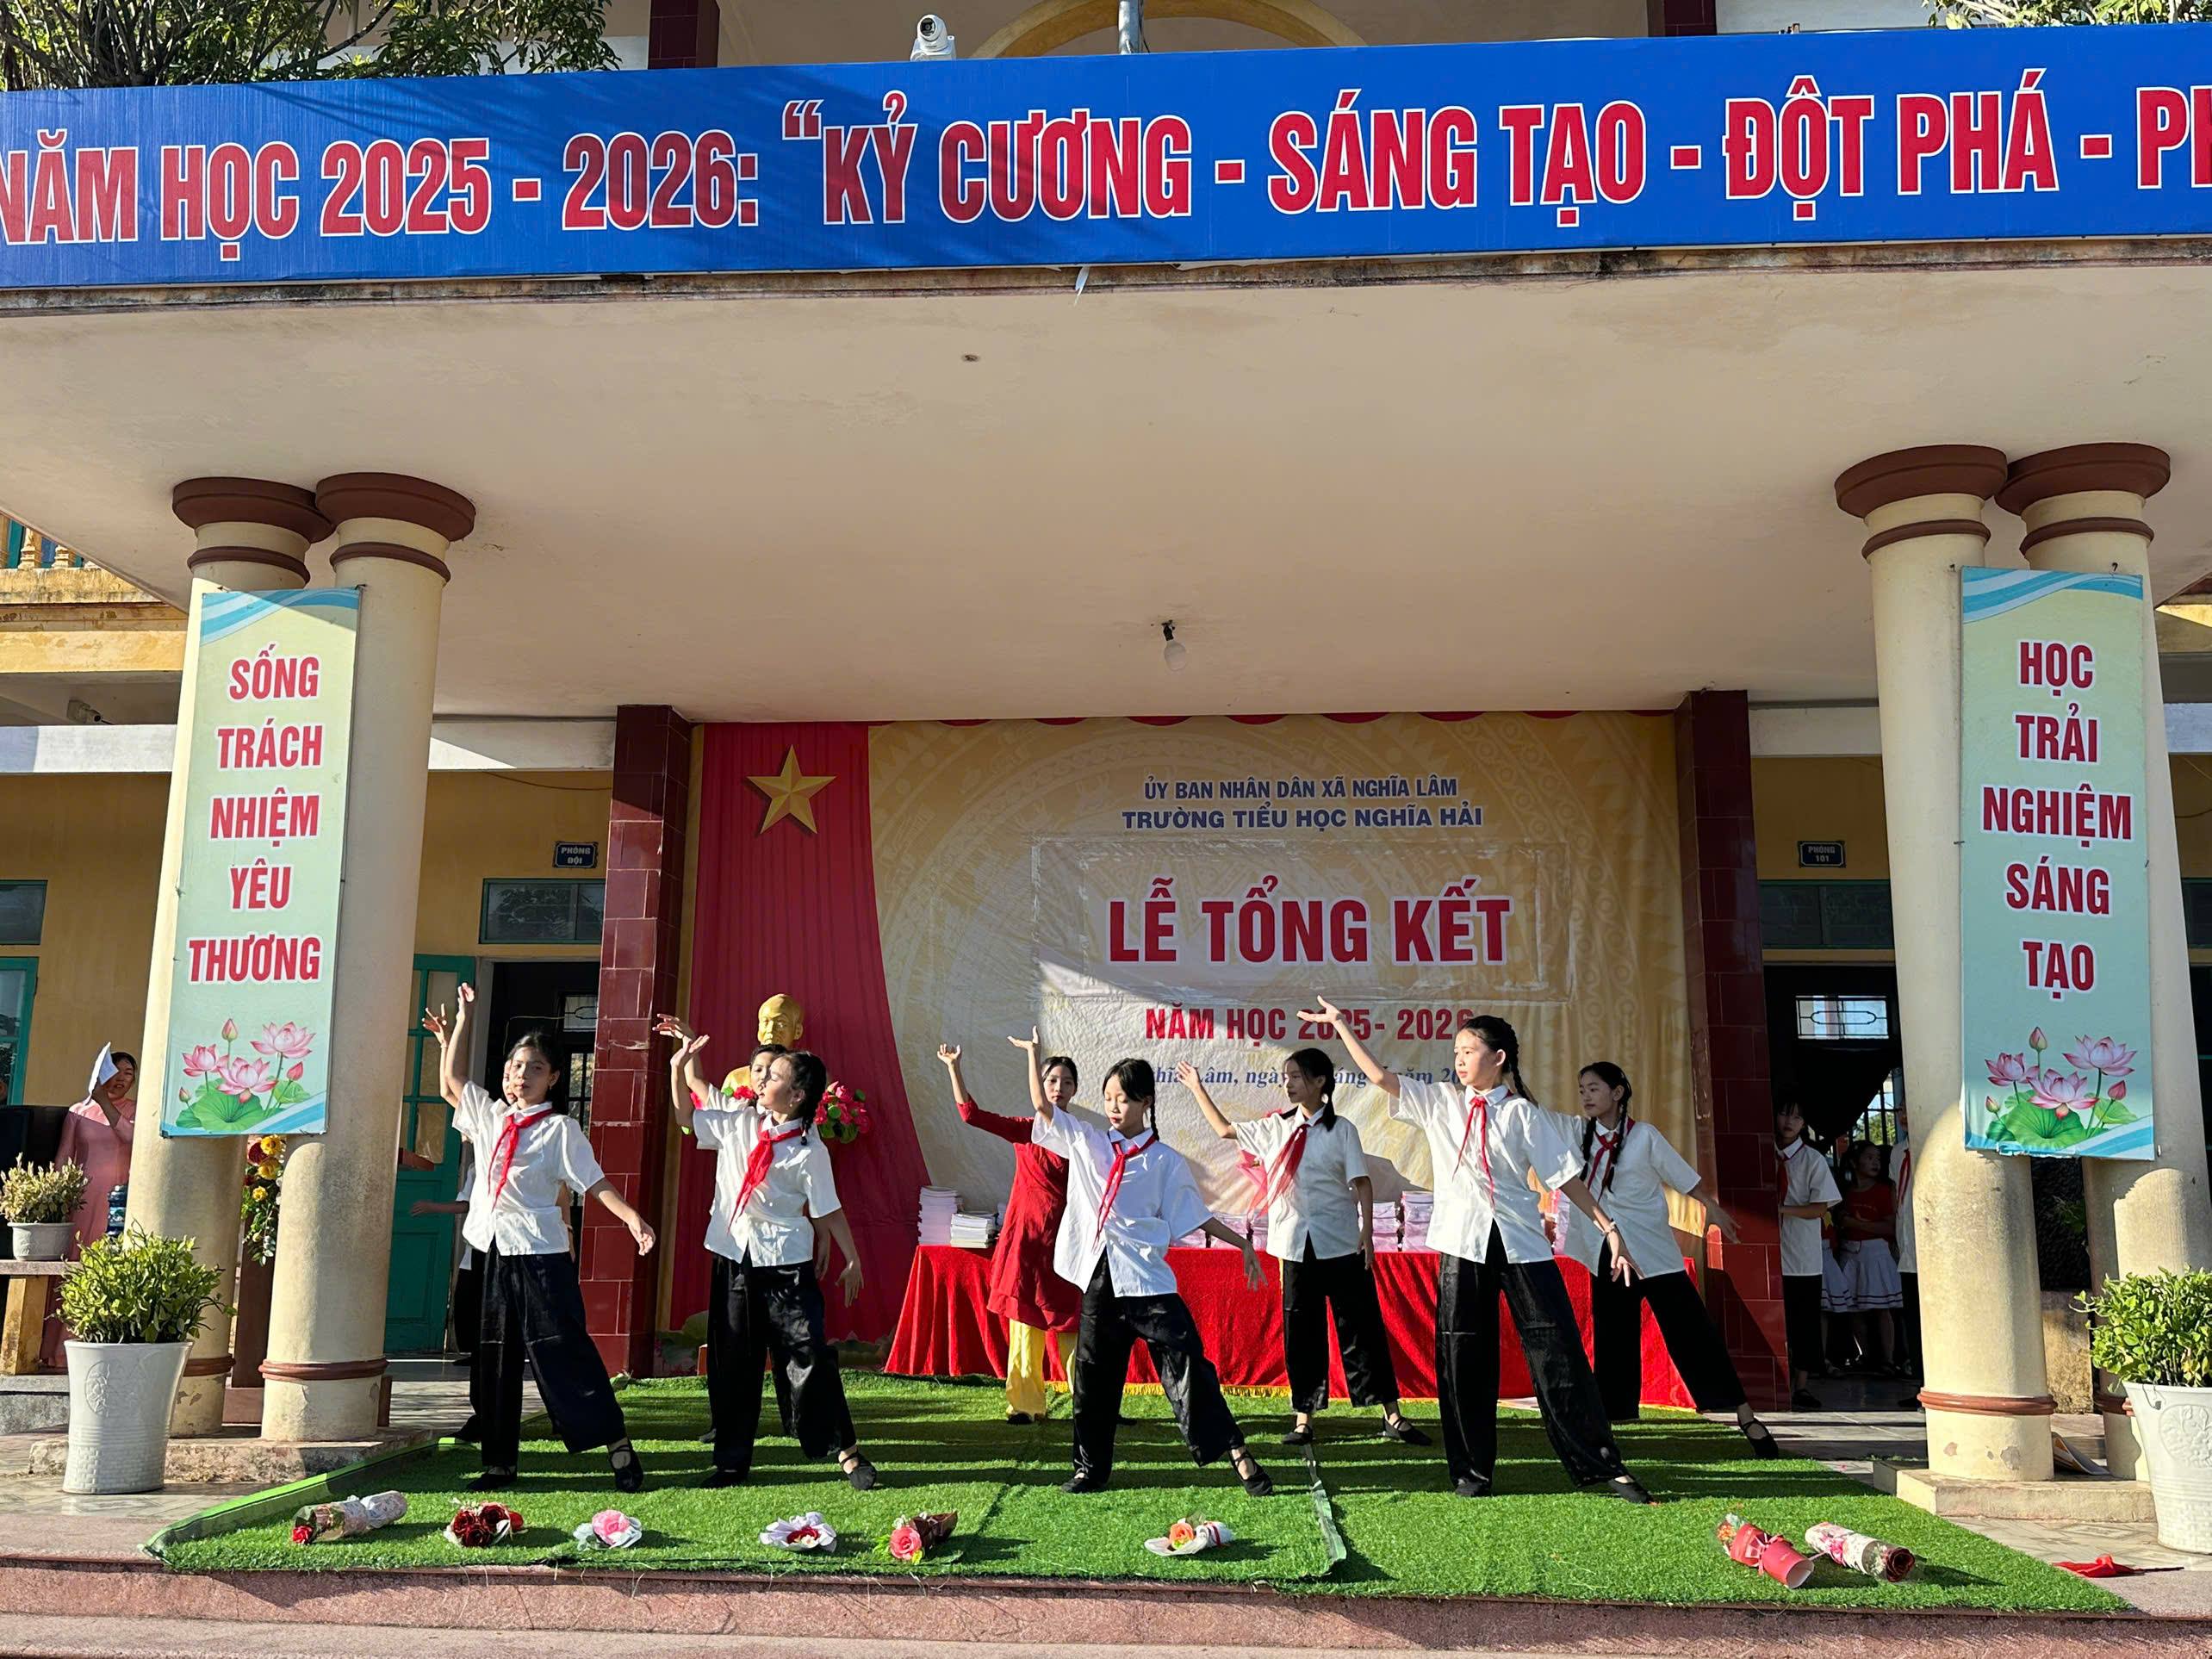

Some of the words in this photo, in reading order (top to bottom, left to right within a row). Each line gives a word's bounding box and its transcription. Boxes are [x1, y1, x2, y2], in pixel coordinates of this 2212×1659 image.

[160, 141, 299, 262] HỌC
[320, 138, 491, 236] 2025
[513, 179, 541, 201] -
[562, 130, 758, 230] 2026:
[940, 109, 1191, 223] CƯƠNG
[1215, 159, 1245, 183] -
[1268, 89, 1477, 214] SÁNG
[1499, 101, 1645, 227] TẠO
[1671, 146, 1701, 169] -
[1723, 76, 1874, 221] ĐỘT
[1897, 69, 2059, 195] PHÁ
[2081, 134, 2112, 158] -
[228, 644, 319, 699] SỐNG
[2020, 642, 2094, 696] HỌC
[217, 718, 322, 768] TRÁCH
[2015, 702, 2098, 762] TRẢI
[1145, 776, 1169, 799] ỦY
[1175, 782, 1213, 799] BAN
[1220, 776, 1271, 798] NHÂN
[1277, 776, 1315, 798] DÂN
[1322, 776, 1345, 798] XÃ
[1352, 775, 1410, 798] NGHĨA
[1416, 774, 1457, 797] LÂM
[210, 788, 320, 847] NHIỆM
[1122, 805, 1225, 829] TRƯỜNG
[1233, 801, 1288, 829] TIỂU
[1296, 808, 1346, 832] HỌC
[1355, 805, 1432, 827] NGHĨA
[1440, 800, 1482, 826] HẢI
[1985, 783, 2132, 848] NGHIỆM
[229, 856, 291, 909] YÊU
[2005, 856, 2109, 915] SÁNG
[1110, 877, 1177, 961] LỄ
[1202, 874, 1368, 962] TỔNG
[1395, 875, 1509, 961] KẾT
[189, 935, 321, 982] THƯƠNG
[2022, 941, 2095, 999] TẠO
[1145, 1003, 1215, 1040] NĂM
[1227, 1009, 1287, 1047] HỌC
[1193, 1066, 1239, 1086] âm,
[1334, 1066, 1367, 1088] áng
